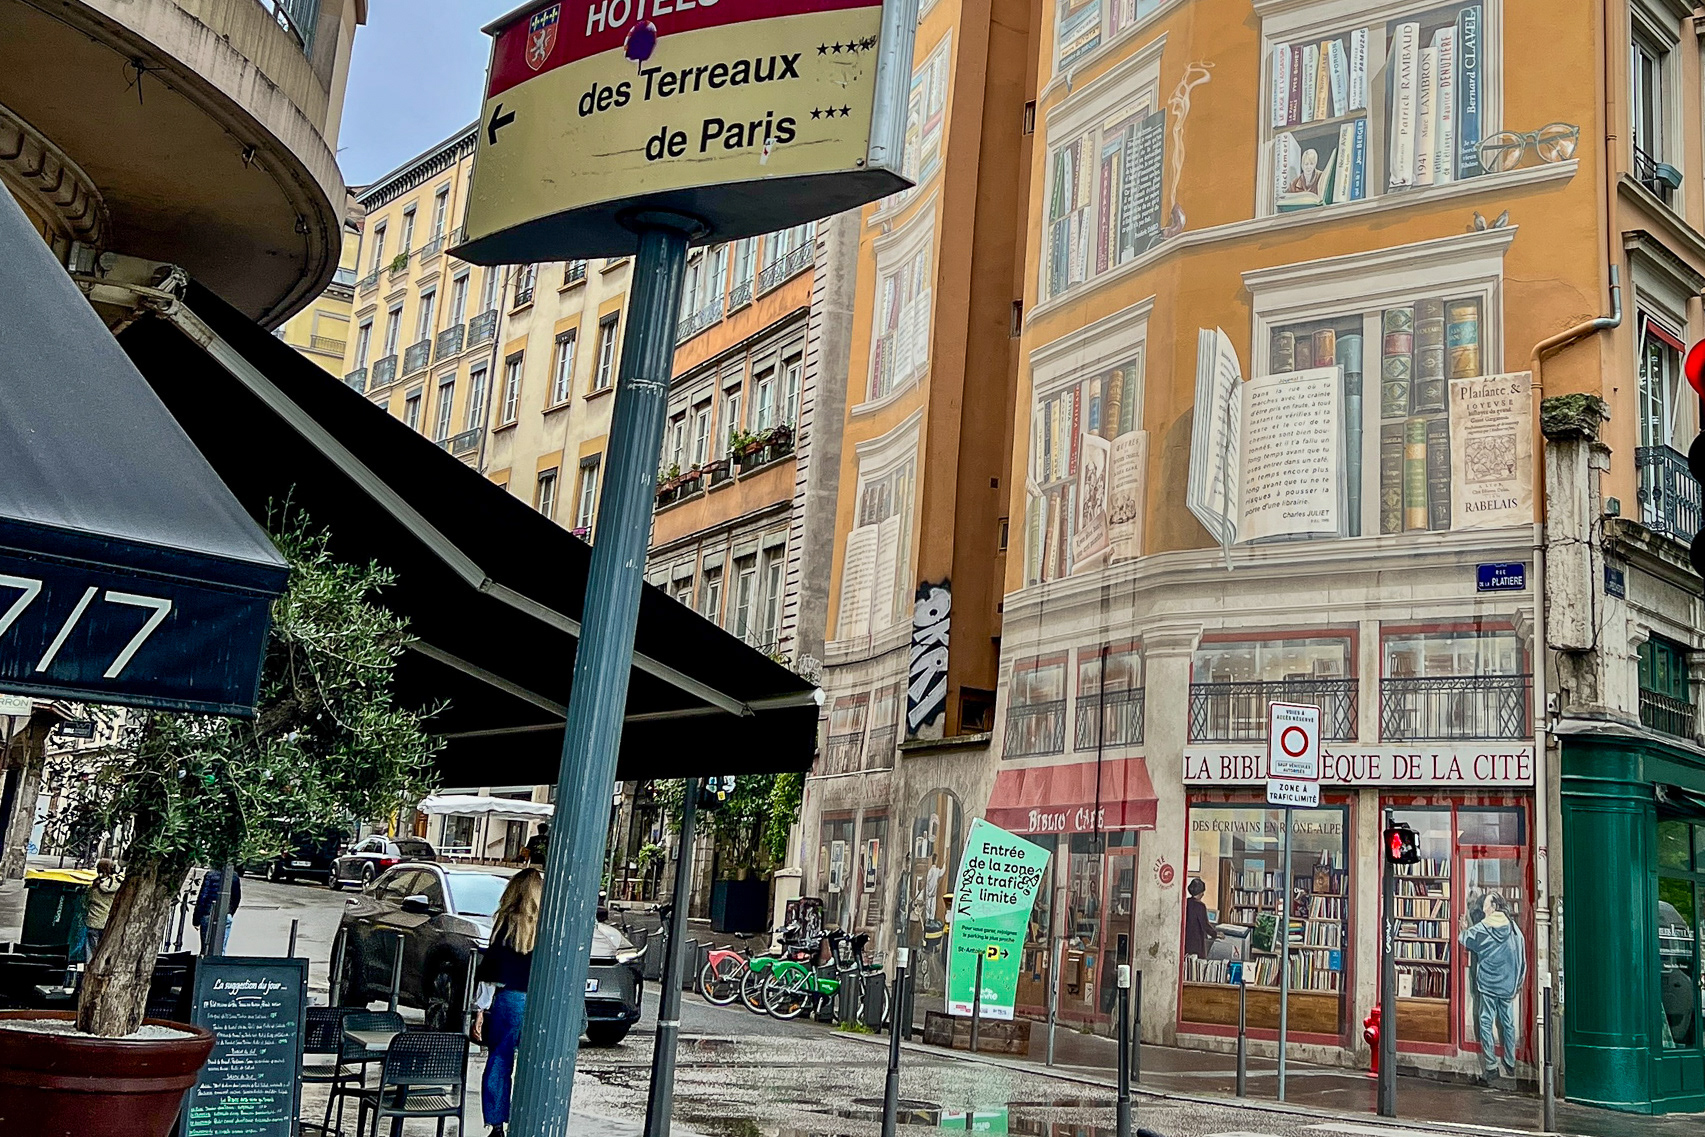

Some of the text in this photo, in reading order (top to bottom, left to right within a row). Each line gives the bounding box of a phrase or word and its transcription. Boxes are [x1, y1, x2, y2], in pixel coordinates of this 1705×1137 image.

[1464, 12, 1476, 113] Bernard CLAVEL
[578, 52, 801, 117] des Terreaux
[1400, 25, 1413, 135] Patrick RAMBAUD
[1421, 53, 1431, 116] LAMBRON
[645, 111, 796, 161] de Paris
[1356, 121, 1364, 148] BERGER
[1417, 153, 1427, 177] 1941
[1252, 391, 1269, 399] Dans
[1510, 384, 1521, 394] &
[1251, 398, 1278, 408] marches
[1467, 399, 1513, 410] IOYEVSE
[1285, 411, 1311, 419] vérifies
[1249, 426, 1268, 435] veste
[1249, 435, 1276, 445] chemise
[1264, 451, 1283, 459] temps
[1286, 448, 1305, 456] avant
[1263, 461, 1282, 469] entrer
[1258, 472, 1280, 480] temps
[1246, 486, 1260, 495] long
[1262, 481, 1282, 490] avant
[1245, 488, 1317, 505] risques pousser
[1244, 506, 1260, 517] porte
[1465, 498, 1518, 513] RABELAIS
[1184, 748, 1531, 783] LA BIBLÈQUE DE LA CITÉ
[1303, 784, 1307, 792] À
[1270, 793, 1317, 803] TRAFIC LIMITÉ
[1193, 818, 1343, 834] DES ÉCRIVAINS EN RÔNE-ALPE
[982, 842, 1025, 859] Entrée
[969, 856, 1034, 875] de la zone
[976, 872, 1024, 890] à trafic
[980, 889, 1017, 905] limité
[213, 978, 223, 990] La
[224, 979, 257, 995] suggestion
[258, 978, 267, 990] du
